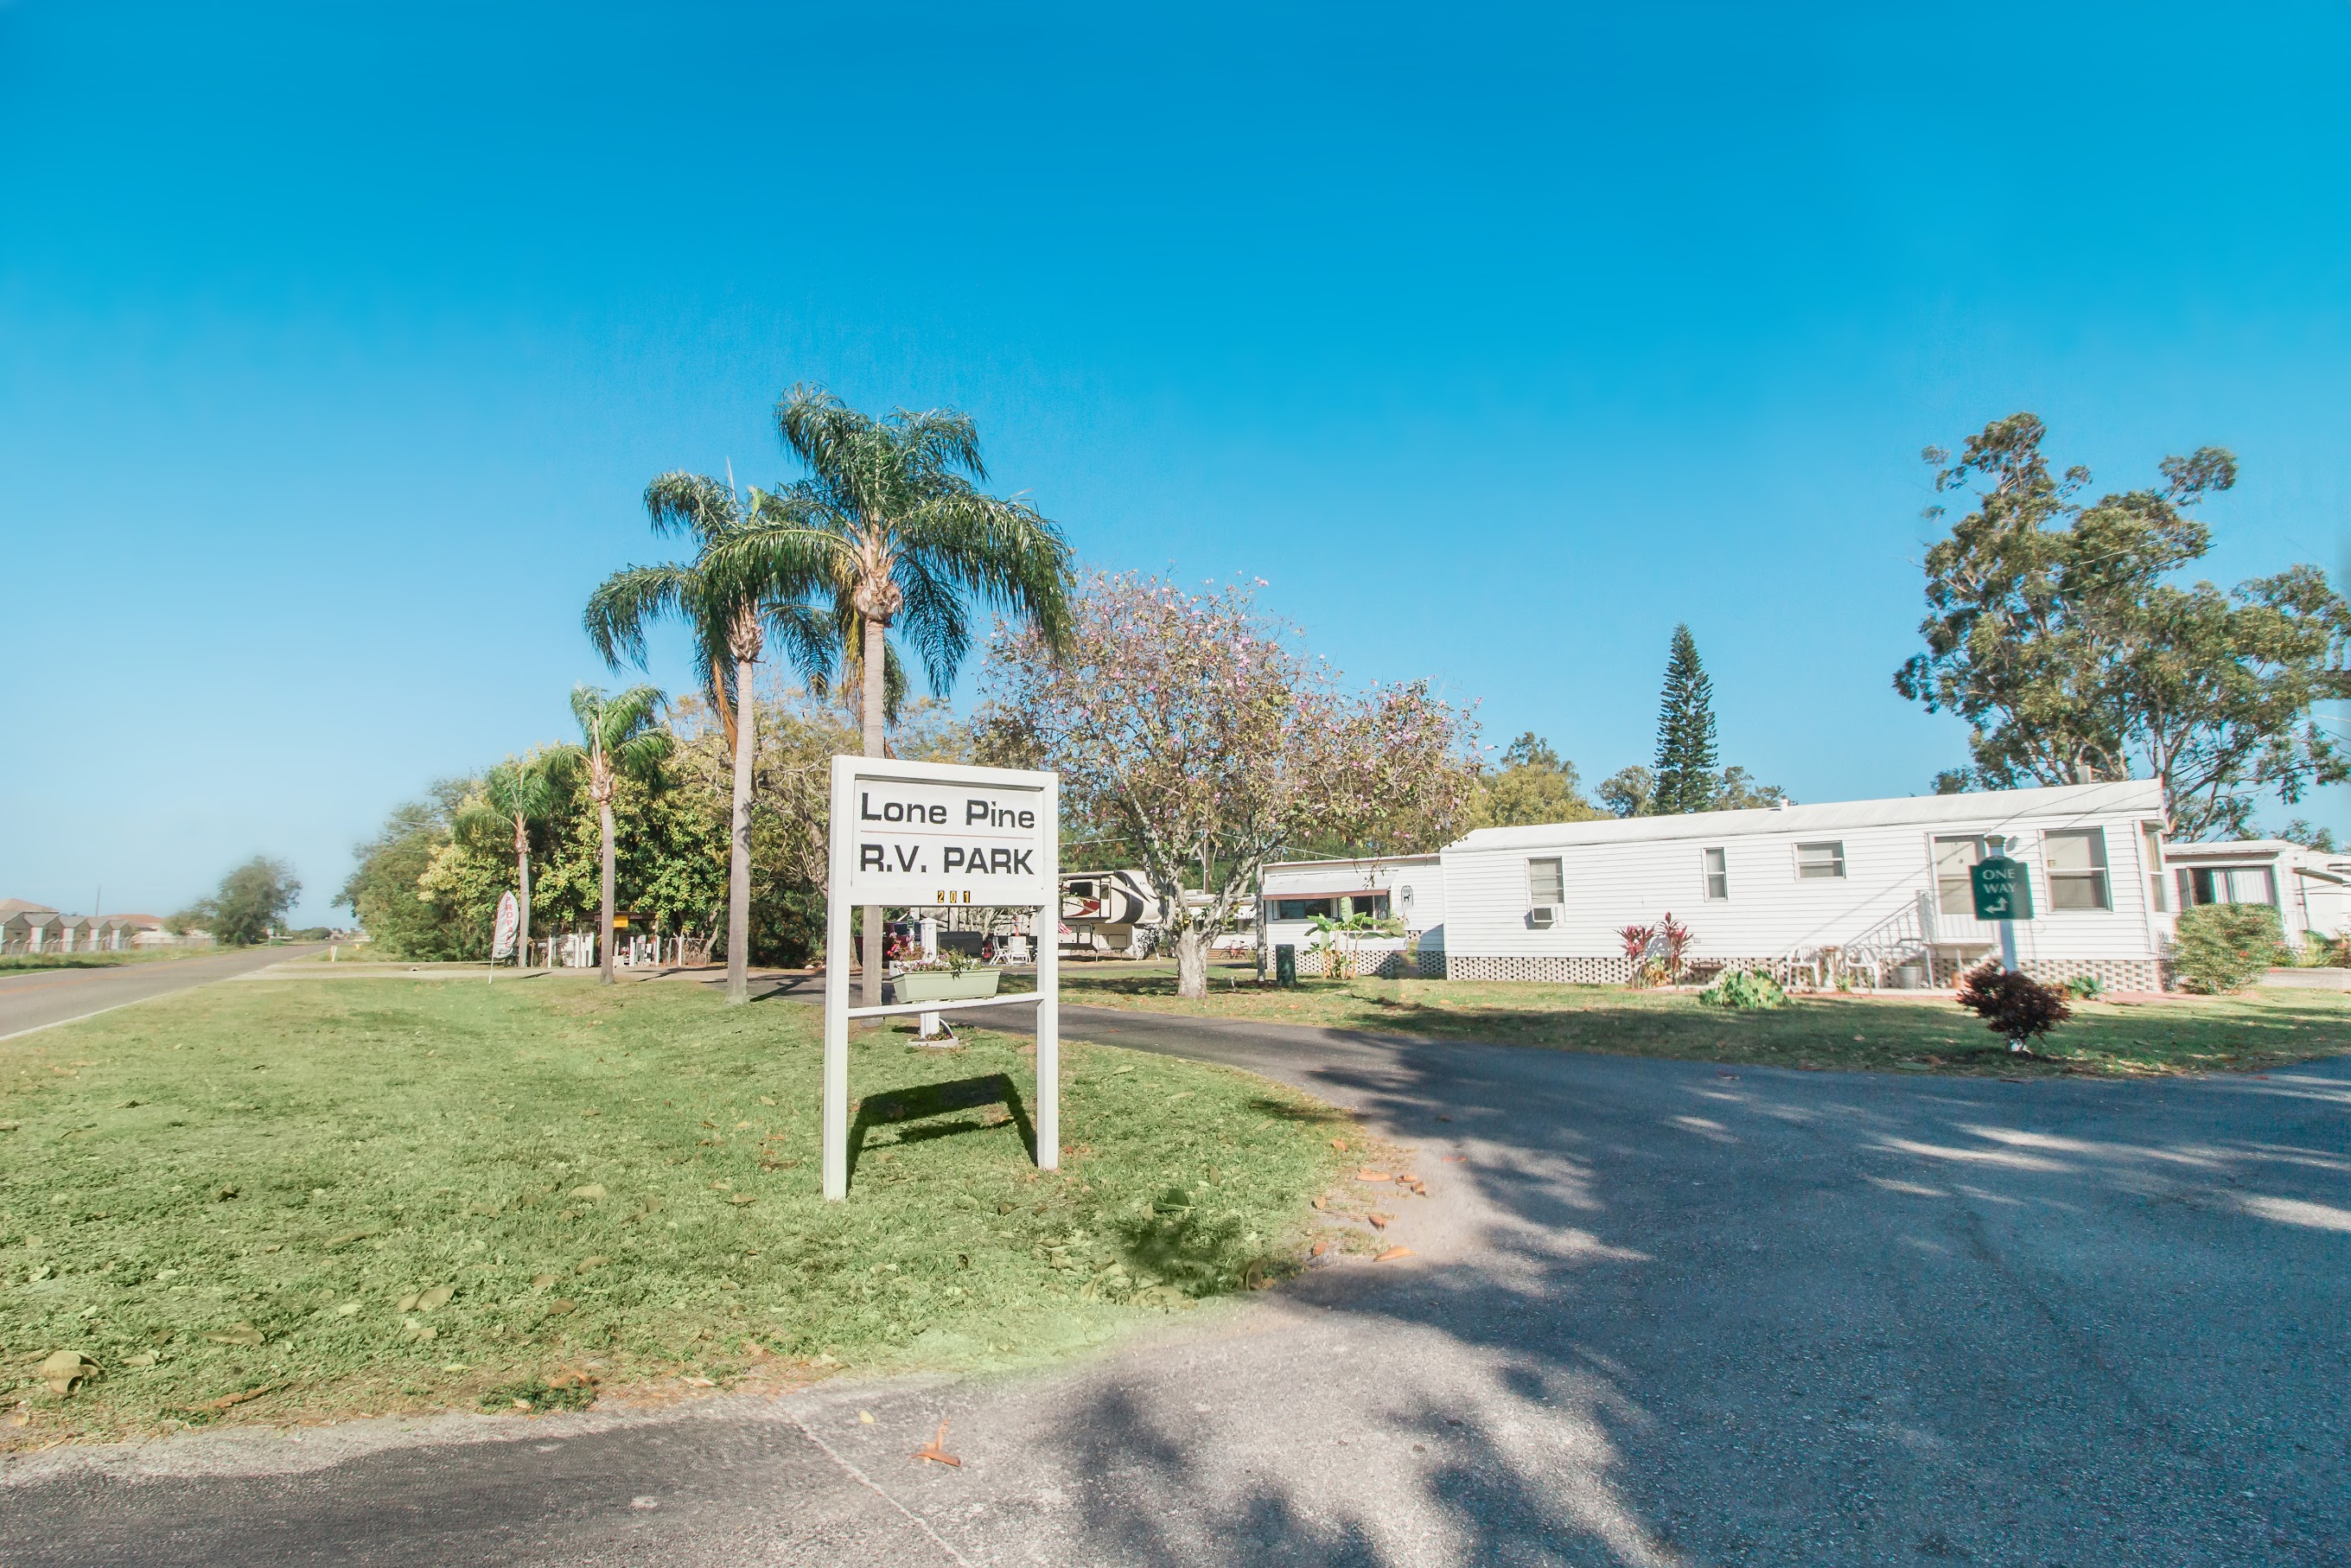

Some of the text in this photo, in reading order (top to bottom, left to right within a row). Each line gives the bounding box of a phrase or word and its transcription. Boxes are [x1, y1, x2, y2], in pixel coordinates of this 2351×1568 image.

[861, 792, 1035, 829] Lone Pine
[860, 843, 1035, 876] R.V. PARK
[1983, 869, 2016, 880] ONE
[1984, 883, 2017, 894] WAY
[937, 890, 971, 903] 201
